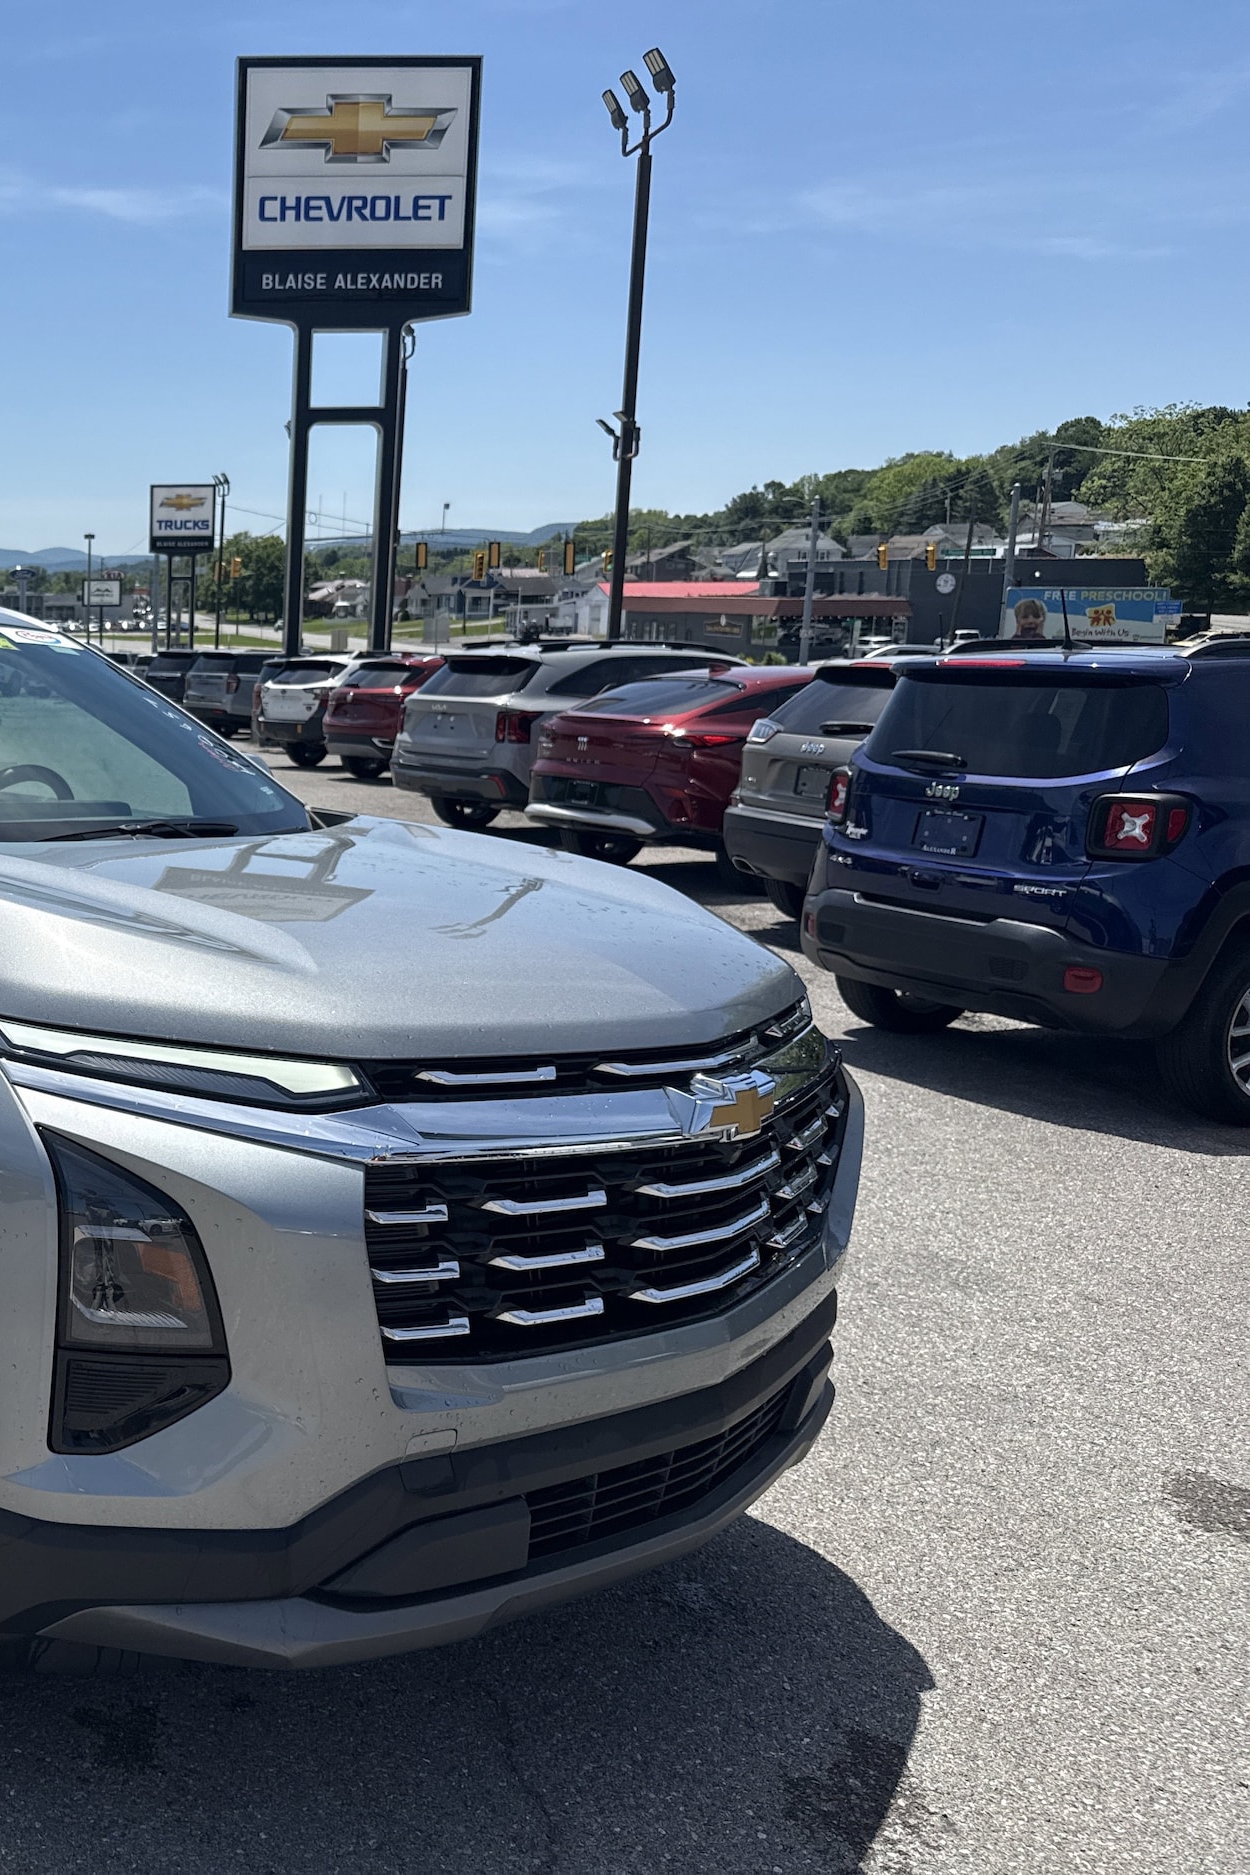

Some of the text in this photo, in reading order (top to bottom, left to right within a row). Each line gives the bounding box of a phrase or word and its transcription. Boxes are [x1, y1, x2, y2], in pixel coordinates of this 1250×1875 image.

[258, 194, 452, 222] CHEVROLET
[261, 272, 443, 290] BLAISE ALEXANDER
[156, 519, 210, 531] TRUCKS
[1043, 590, 1167, 601] FREE PRESCHOOL!
[800, 740, 825, 757] Jeep
[924, 781, 960, 801] Jeep
[1013, 883, 1067, 897] SPORT
